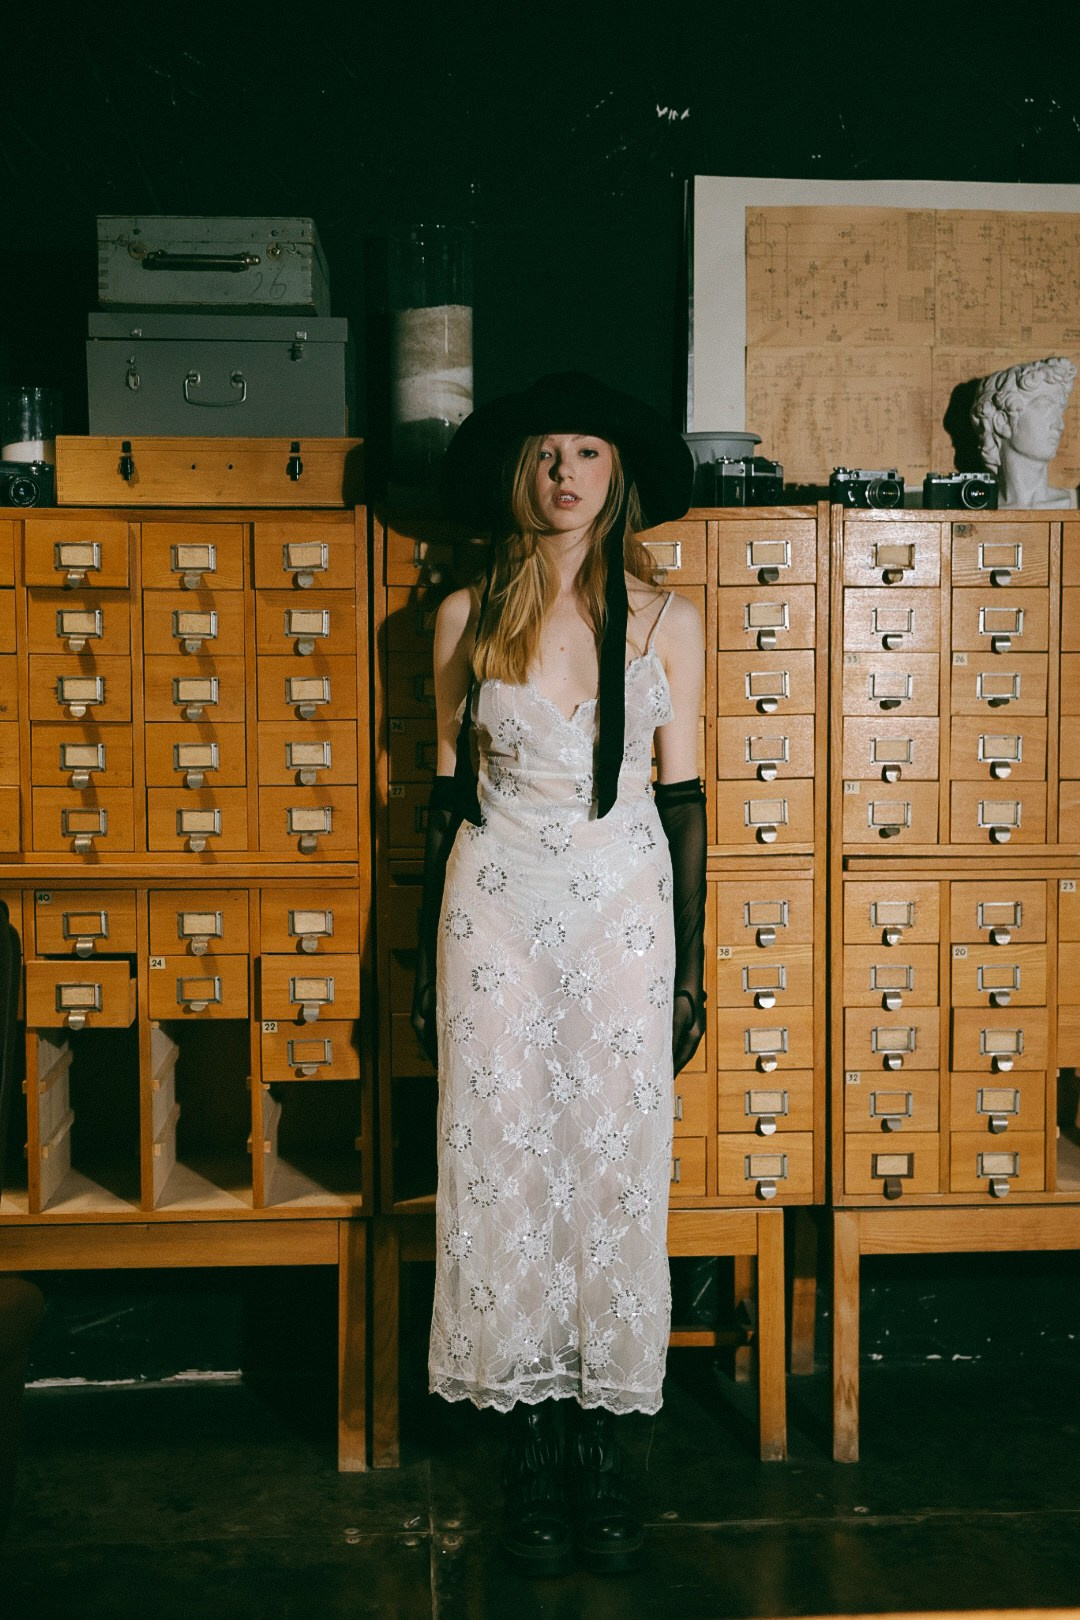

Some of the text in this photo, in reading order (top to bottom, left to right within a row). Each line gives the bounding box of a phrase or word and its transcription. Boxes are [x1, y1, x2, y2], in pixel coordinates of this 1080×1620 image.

[1063, 882, 1074, 890] 23
[37, 893, 49, 902] 40
[719, 948, 730, 956] 38
[955, 948, 966, 956] 20
[152, 959, 162, 967] 24
[264, 1023, 276, 1031] 22
[848, 1073, 858, 1081] 32
